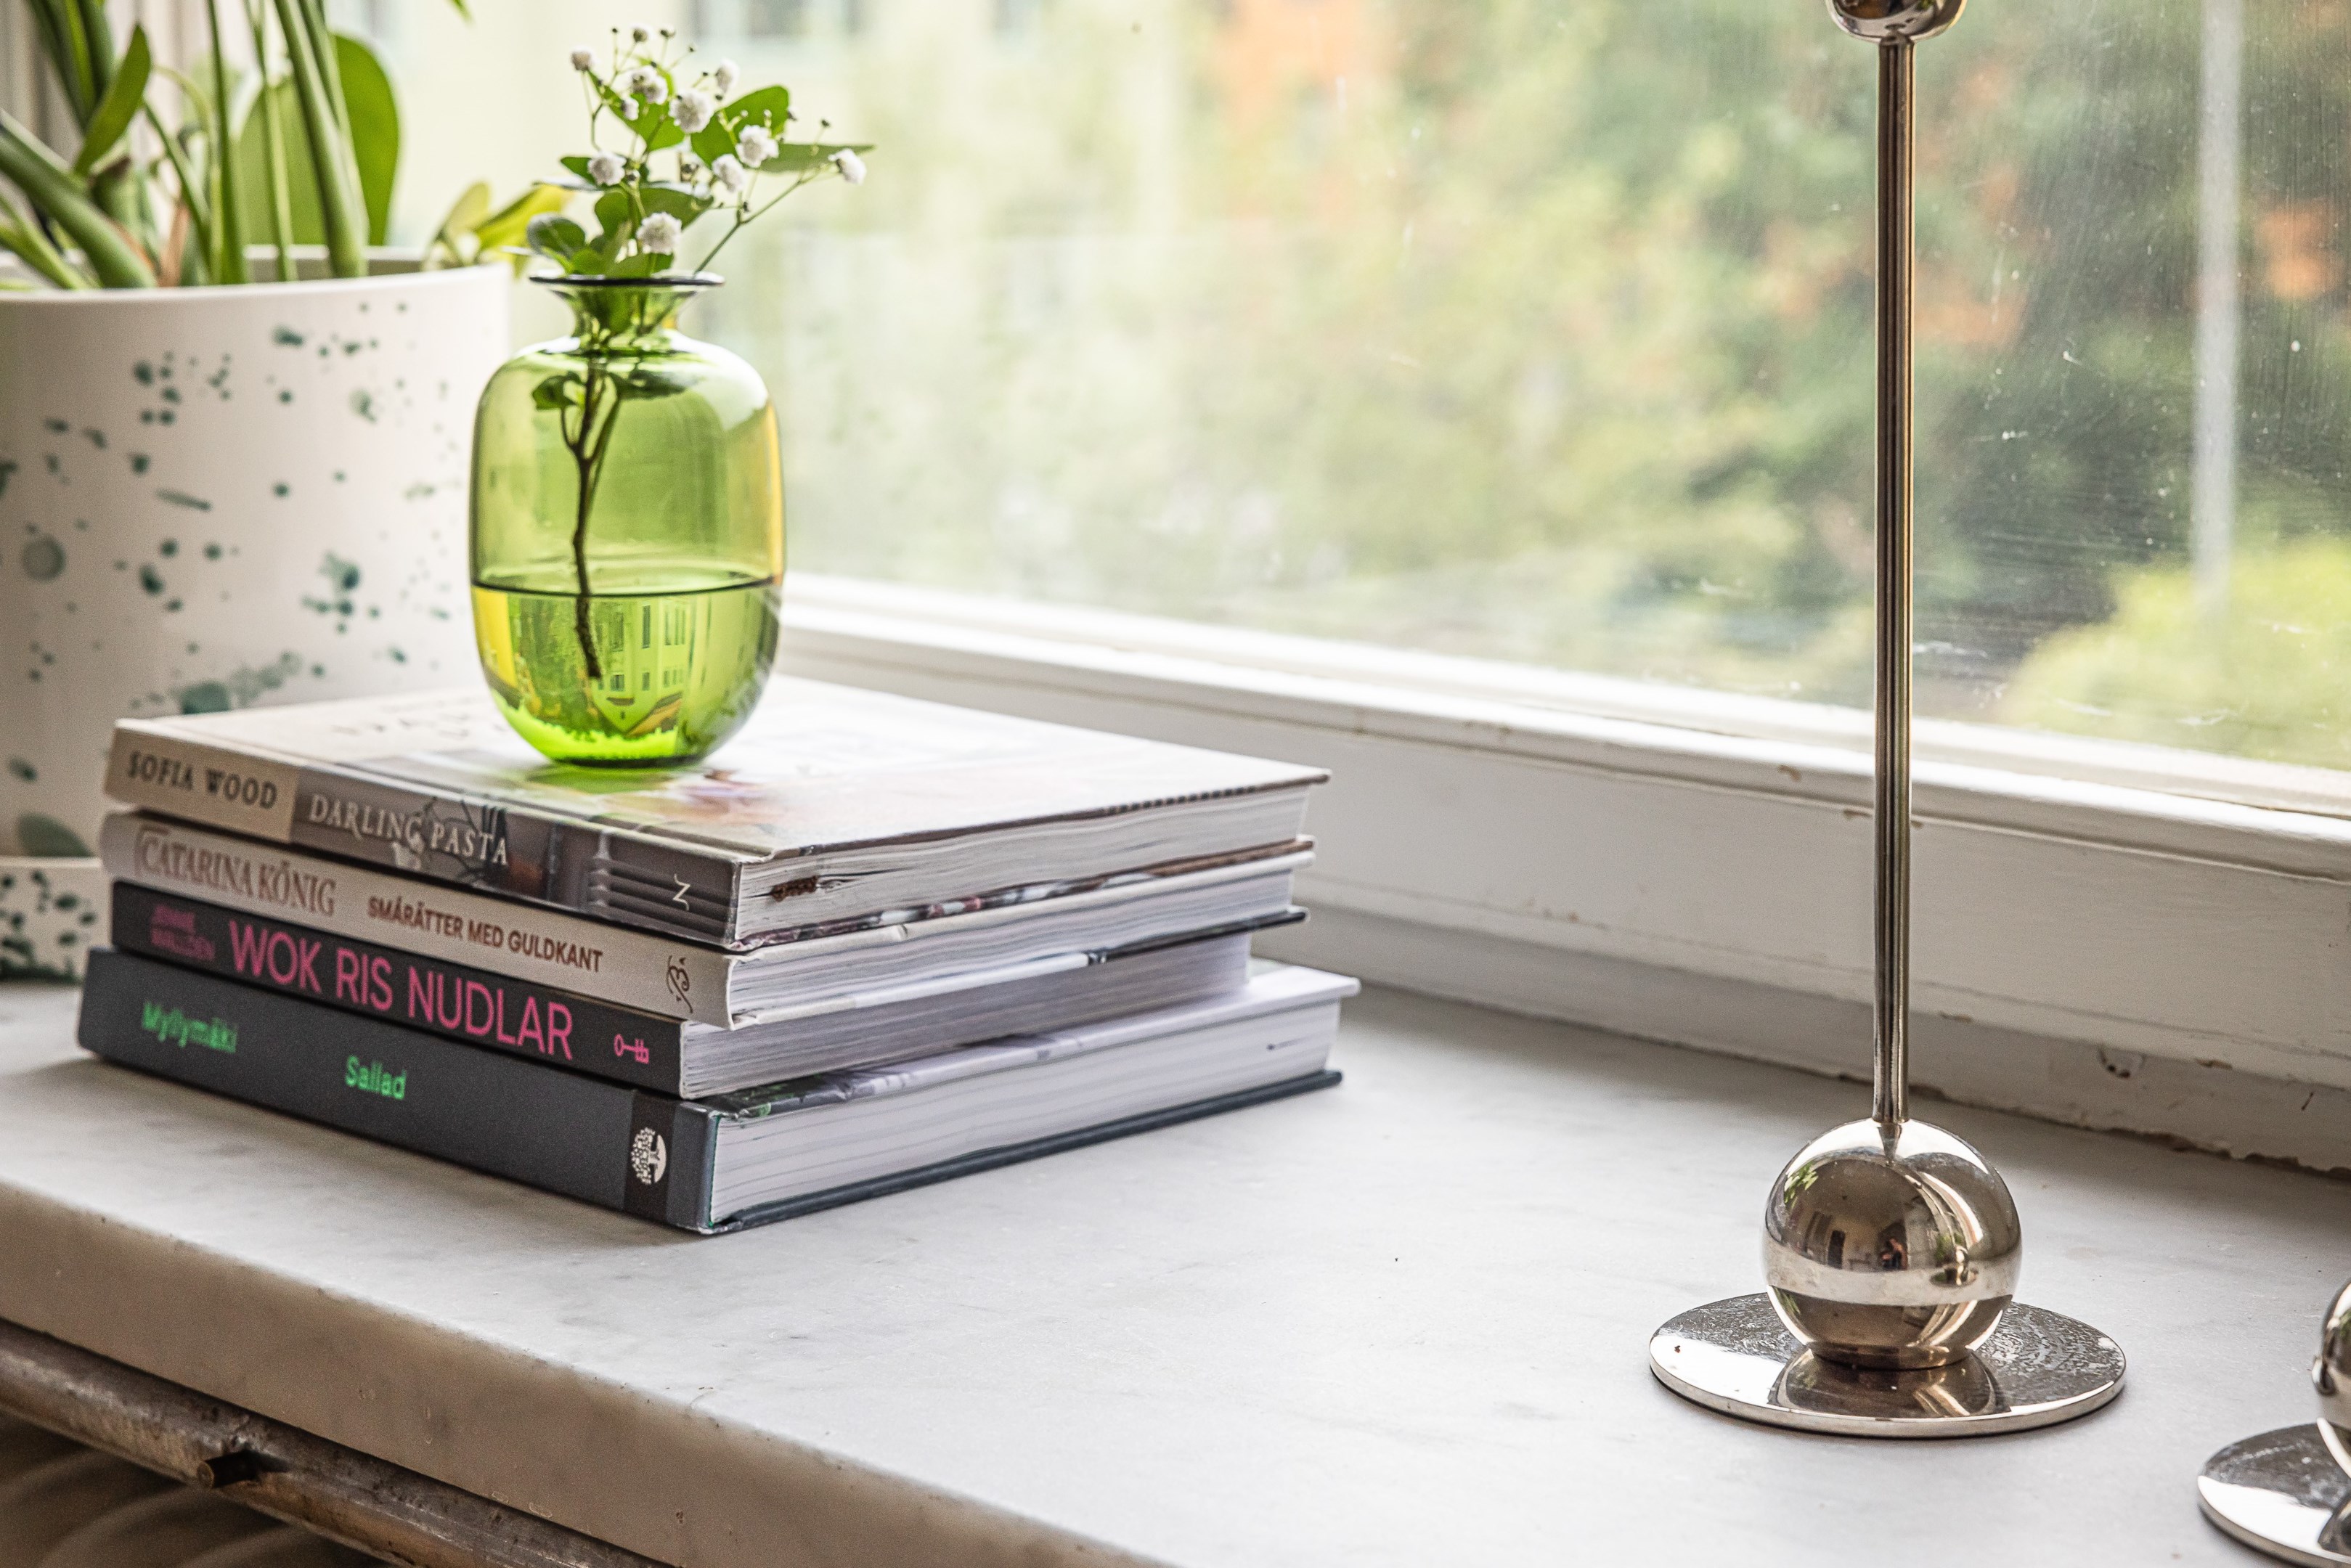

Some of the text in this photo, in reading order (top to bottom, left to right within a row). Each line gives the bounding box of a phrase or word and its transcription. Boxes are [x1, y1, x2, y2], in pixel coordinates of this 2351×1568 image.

[128, 749, 278, 809] SOFIA WOOD
[309, 794, 508, 865] DARLING PASTA
[258, 858, 336, 916] KÖNIG
[367, 895, 603, 973] SMÅRÄTTER MED GULDKANT
[229, 920, 323, 995] WOK
[336, 948, 394, 1010] RIS
[407, 965, 574, 1061] NUDLAR
[345, 1055, 407, 1100] Sallad
